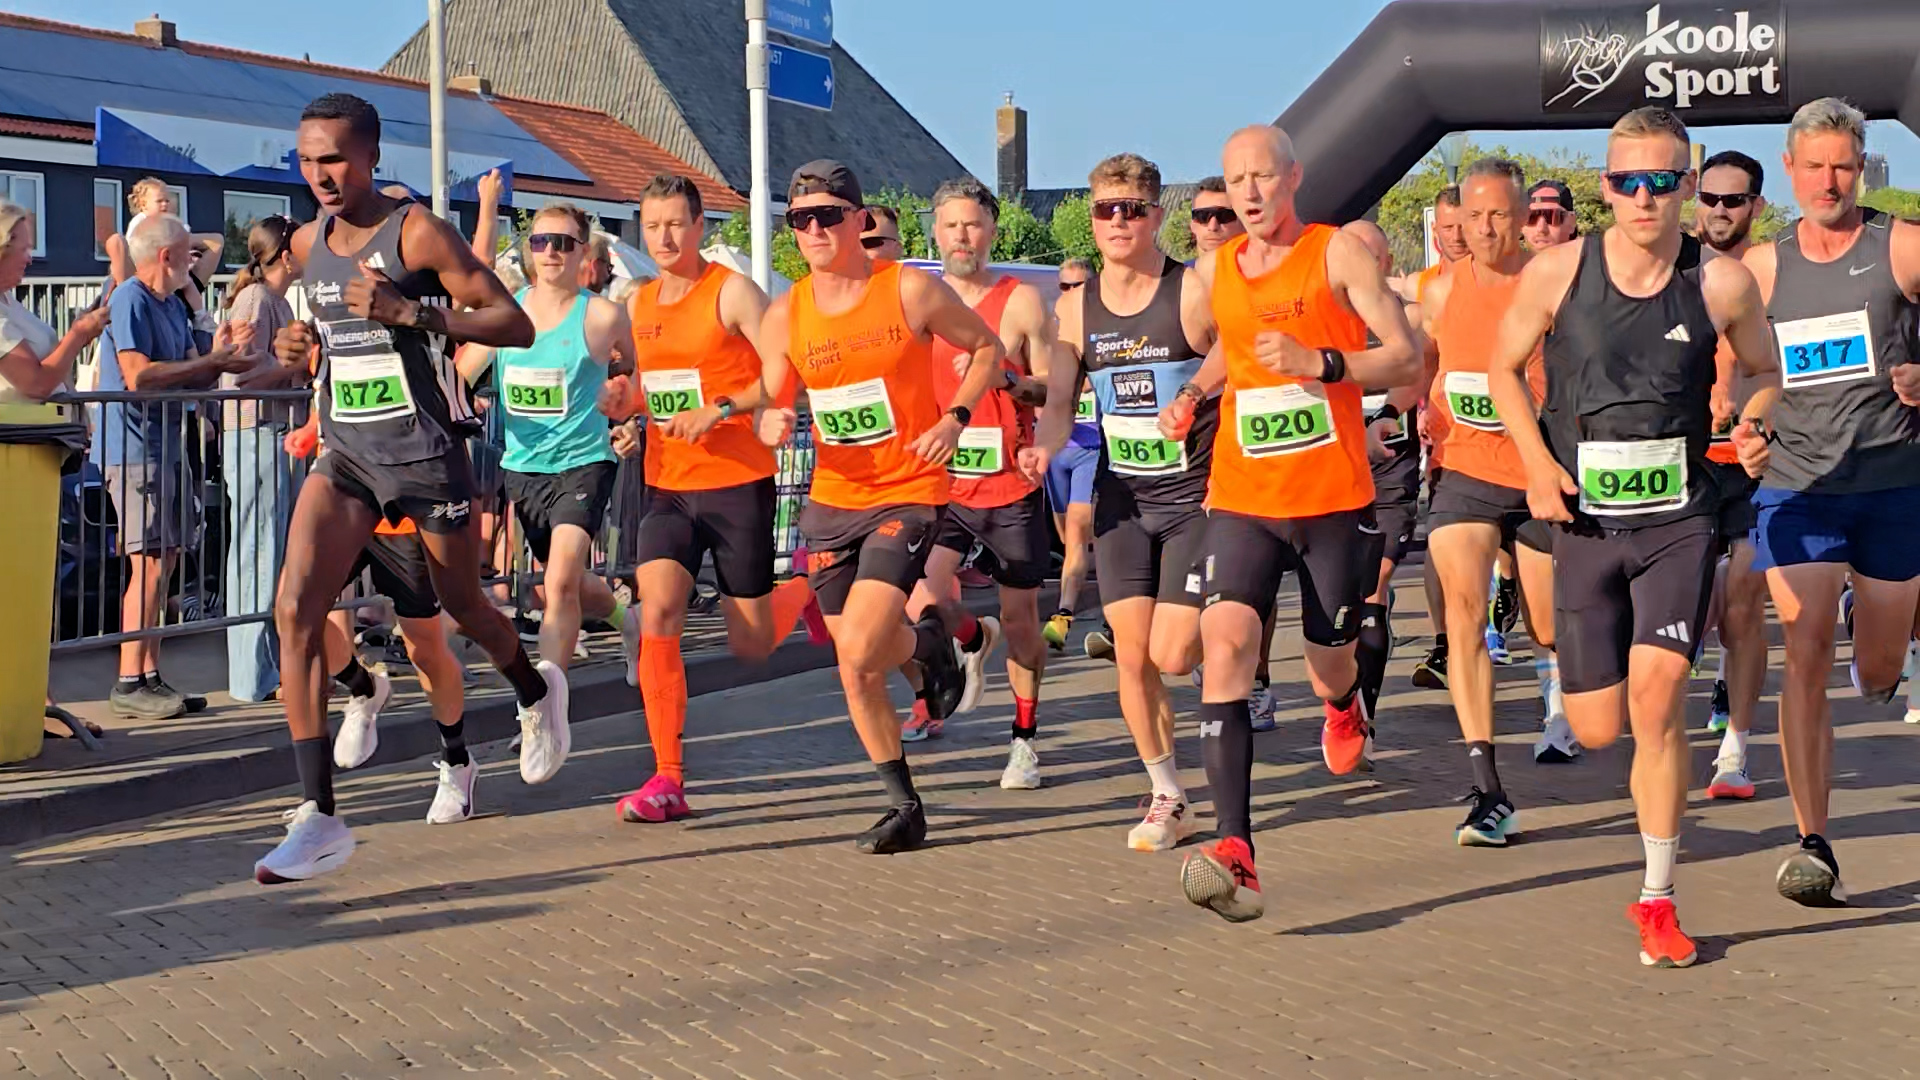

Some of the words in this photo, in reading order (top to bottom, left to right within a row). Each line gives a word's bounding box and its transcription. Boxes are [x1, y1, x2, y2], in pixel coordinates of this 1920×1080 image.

[1644, 3, 1775, 55] koole
[1645, 57, 1781, 108] Sport
[1095, 337, 1134, 355] Sports
[1793, 340, 1853, 371] 317
[341, 380, 394, 407] 872
[511, 386, 551, 406] 931
[651, 391, 691, 413] 902
[1460, 395, 1493, 418] 88
[823, 406, 877, 434] 936
[1250, 409, 1315, 442] 920
[954, 447, 988, 468] 57
[1117, 439, 1166, 462] 961
[1598, 468, 1669, 498] 940
